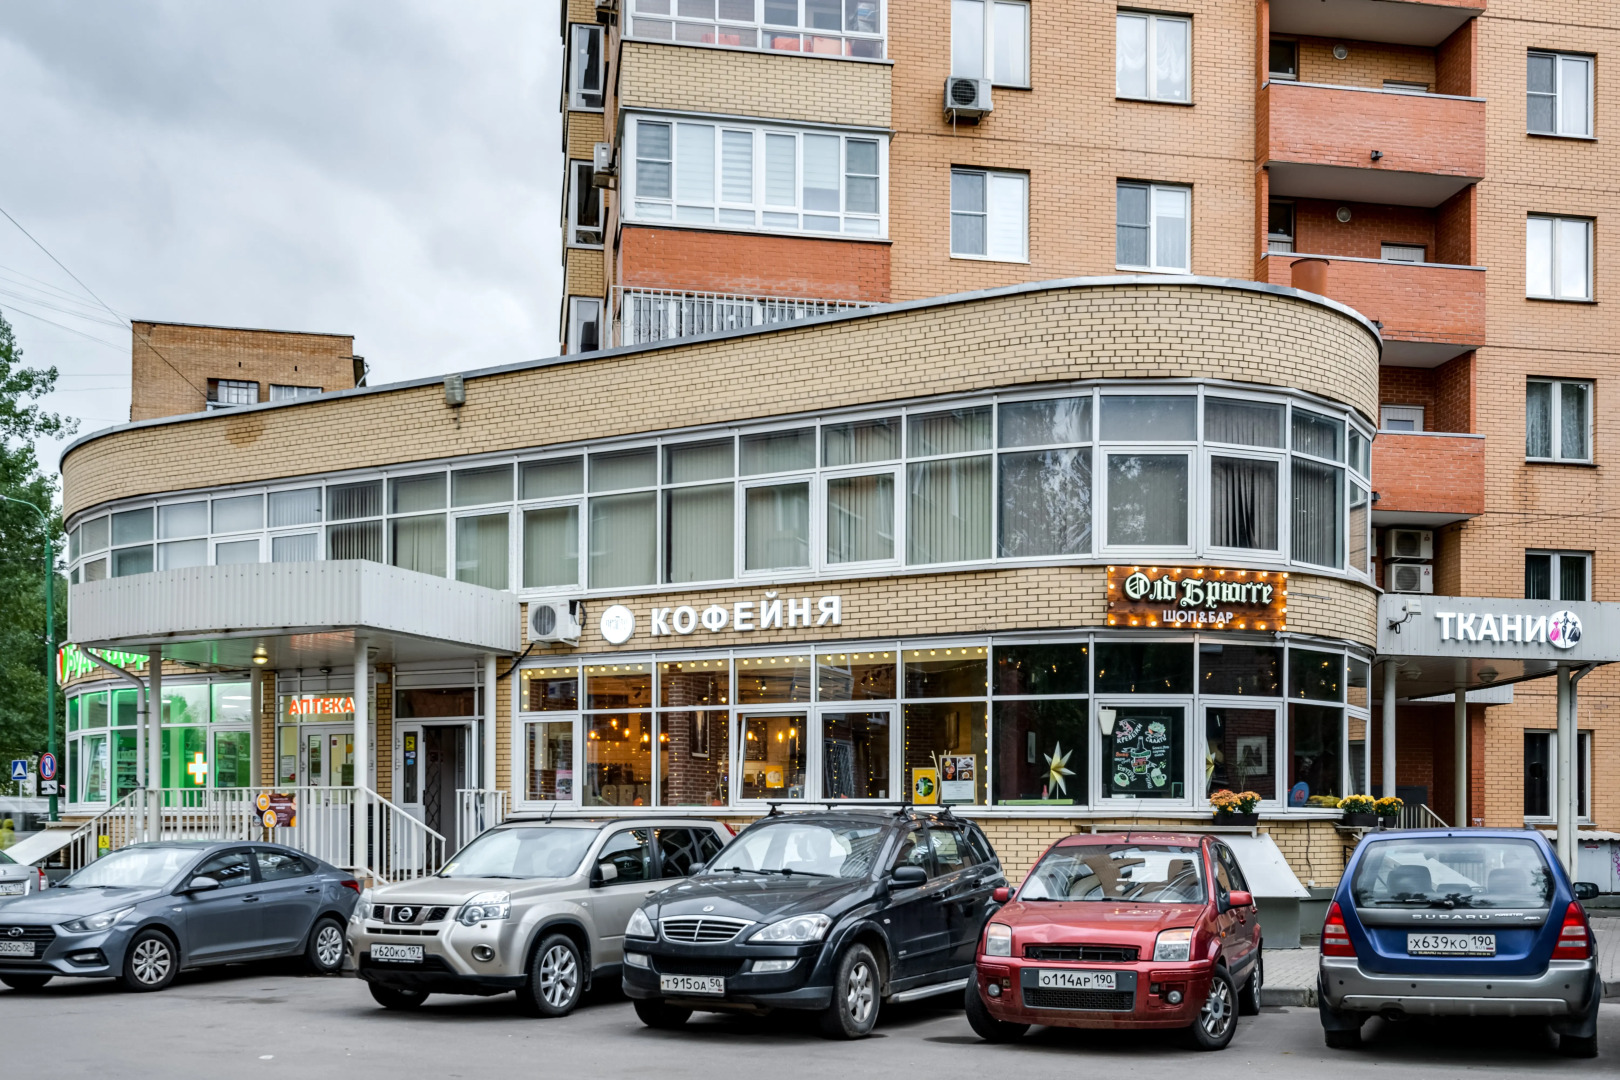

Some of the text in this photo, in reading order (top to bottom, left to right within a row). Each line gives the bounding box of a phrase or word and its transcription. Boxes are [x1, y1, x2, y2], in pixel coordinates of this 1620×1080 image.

[1125, 572, 1274, 609] Олд Брюгге
[651, 591, 842, 636] КОФЕЙНЯ
[1162, 609, 1234, 624] ШОП&БАР
[1435, 611, 1547, 643] ТКАНИ
[288, 696, 356, 716] АПТЕКА
[1094, 974, 1113, 984] 190
